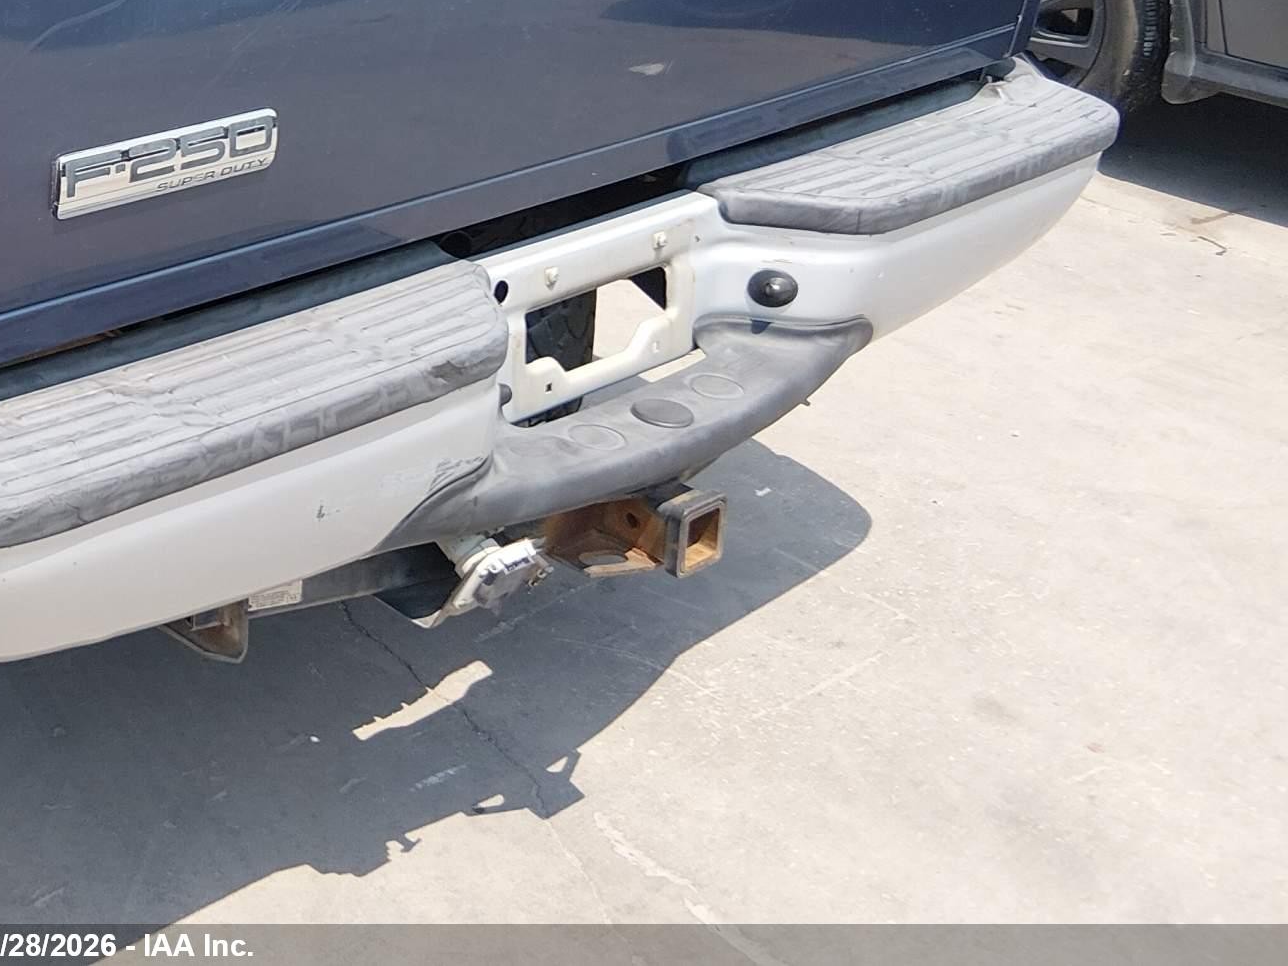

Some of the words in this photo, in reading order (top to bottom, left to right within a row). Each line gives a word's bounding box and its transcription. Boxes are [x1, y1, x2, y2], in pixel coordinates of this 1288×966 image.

[64, 115, 273, 198] F-250
[155, 170, 216, 192] SUPER
[220, 157, 267, 176] DUTY
